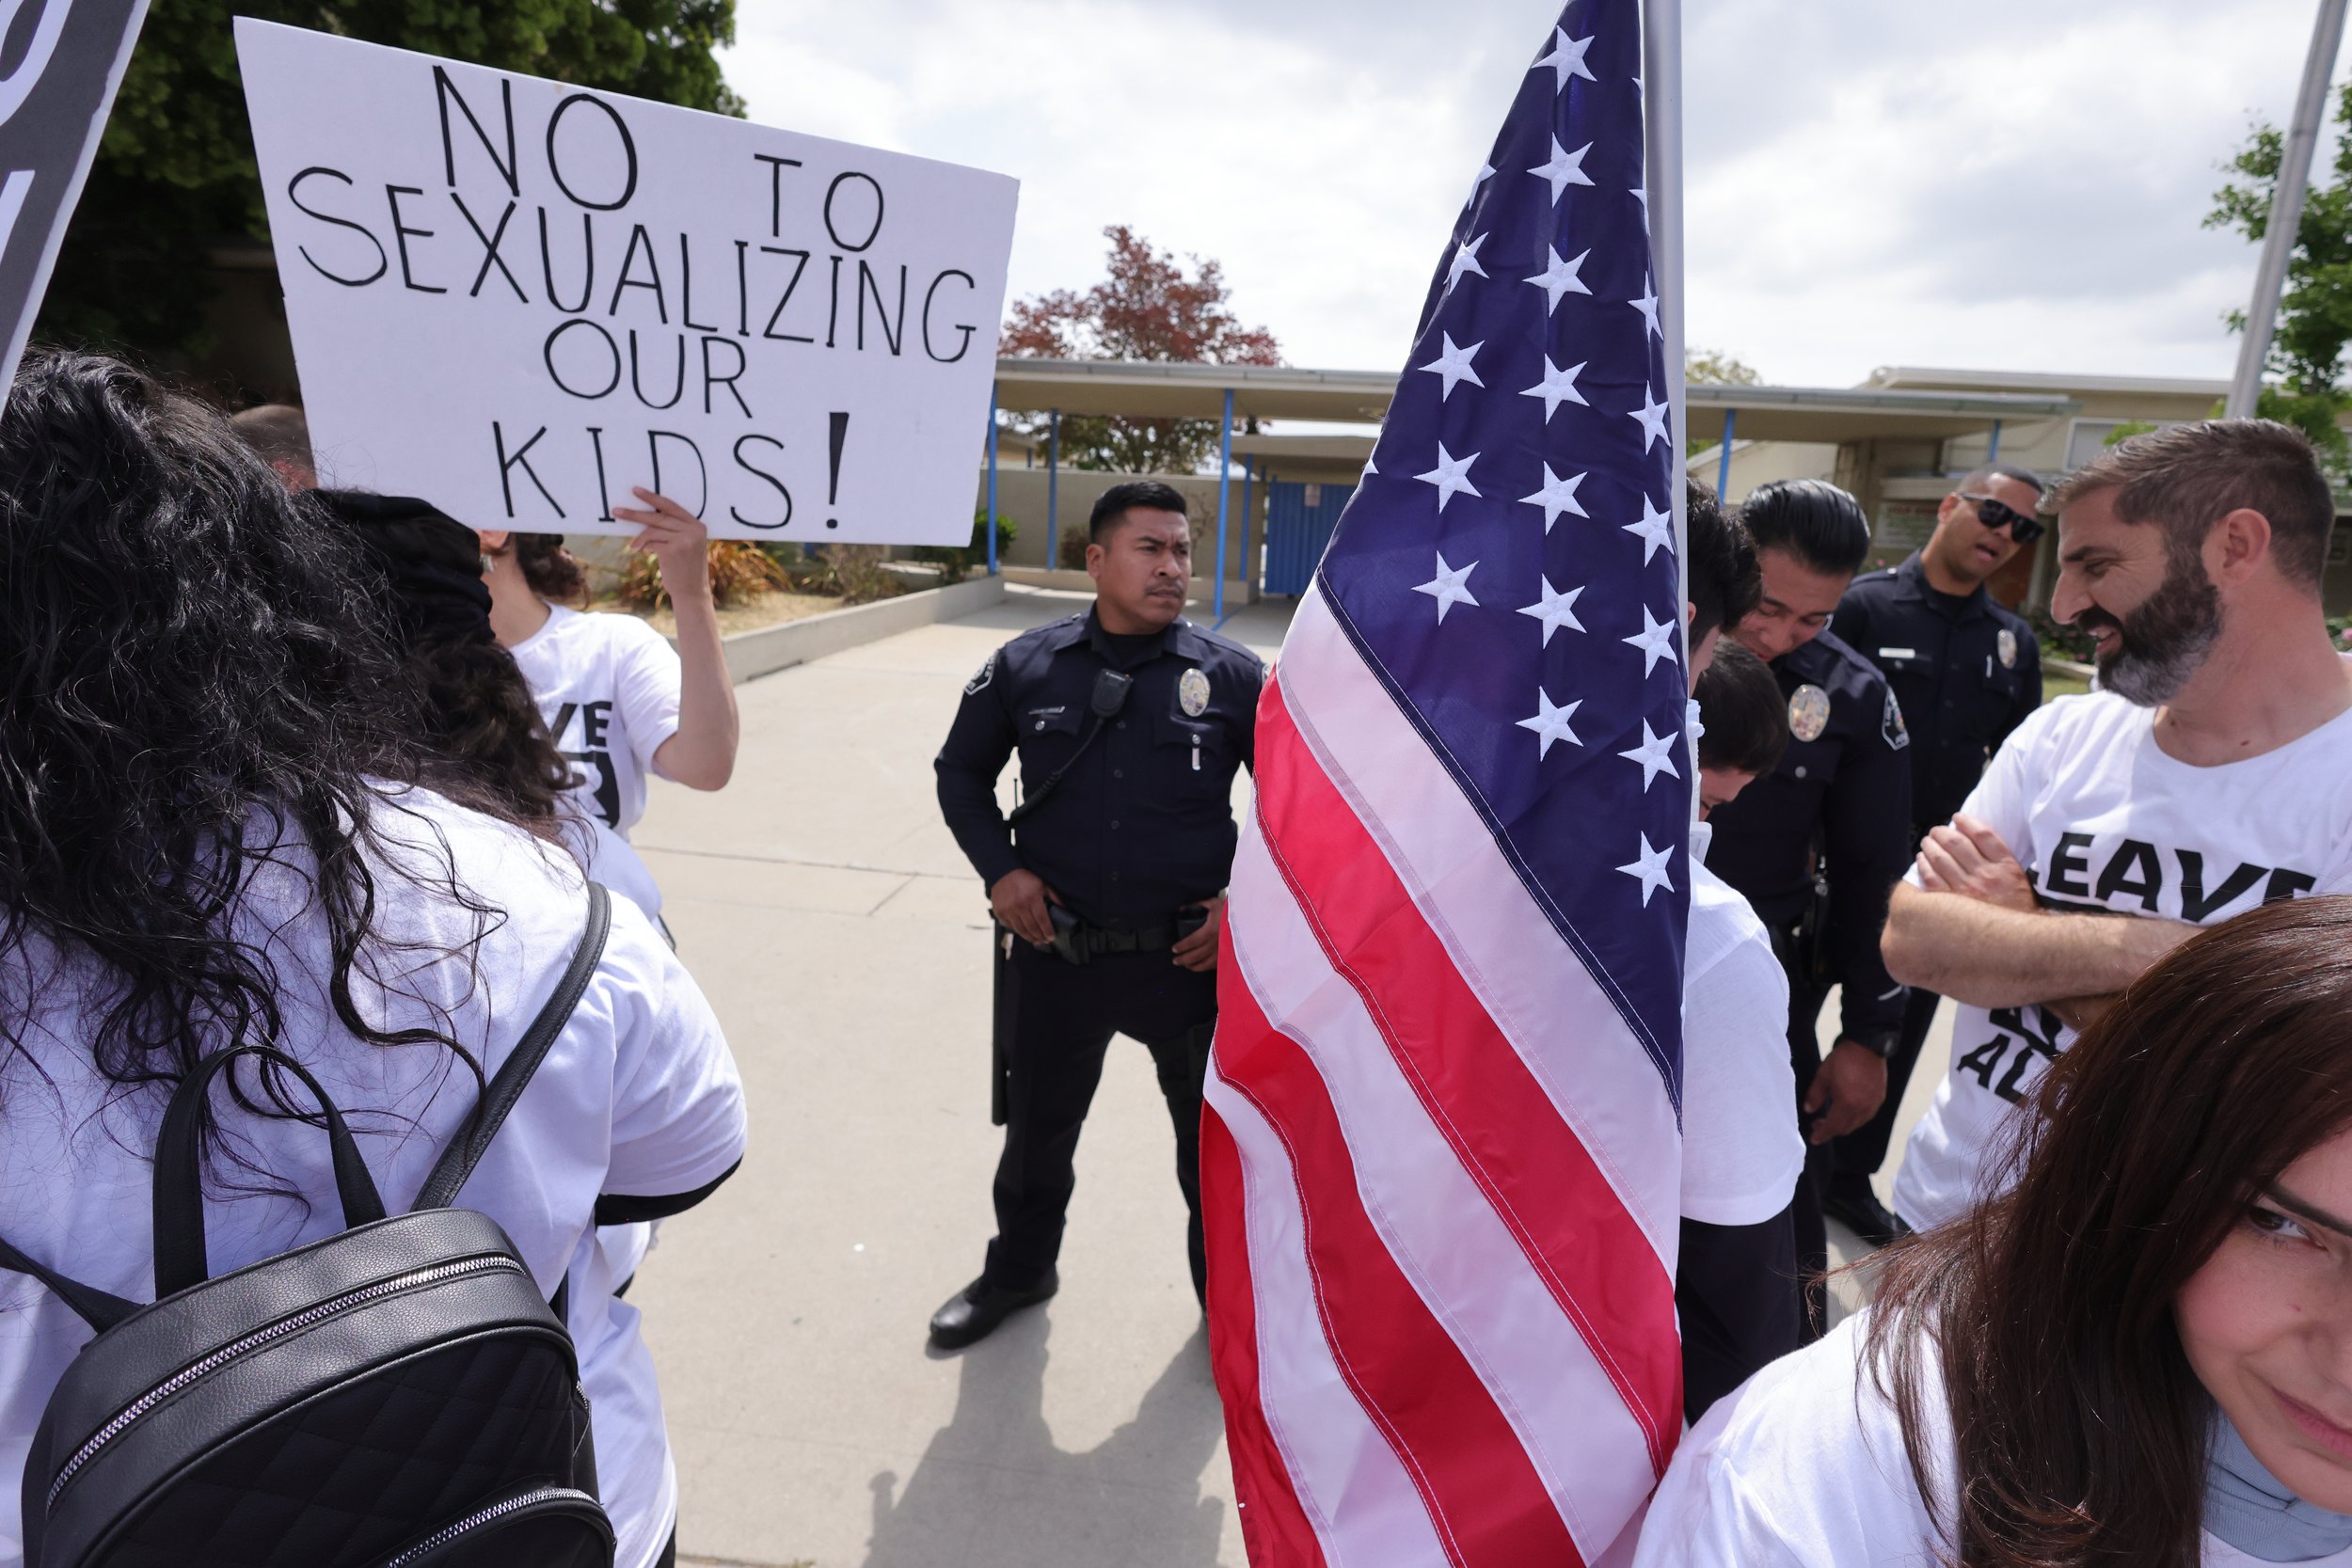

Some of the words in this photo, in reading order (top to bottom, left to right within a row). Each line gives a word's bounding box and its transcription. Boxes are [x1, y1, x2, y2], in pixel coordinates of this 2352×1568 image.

[432, 65, 638, 212] NO
[754, 153, 884, 253] TO
[288, 166, 977, 365] SEXUALIZING
[543, 318, 753, 419] OUR
[492, 411, 850, 530] KIDS!
